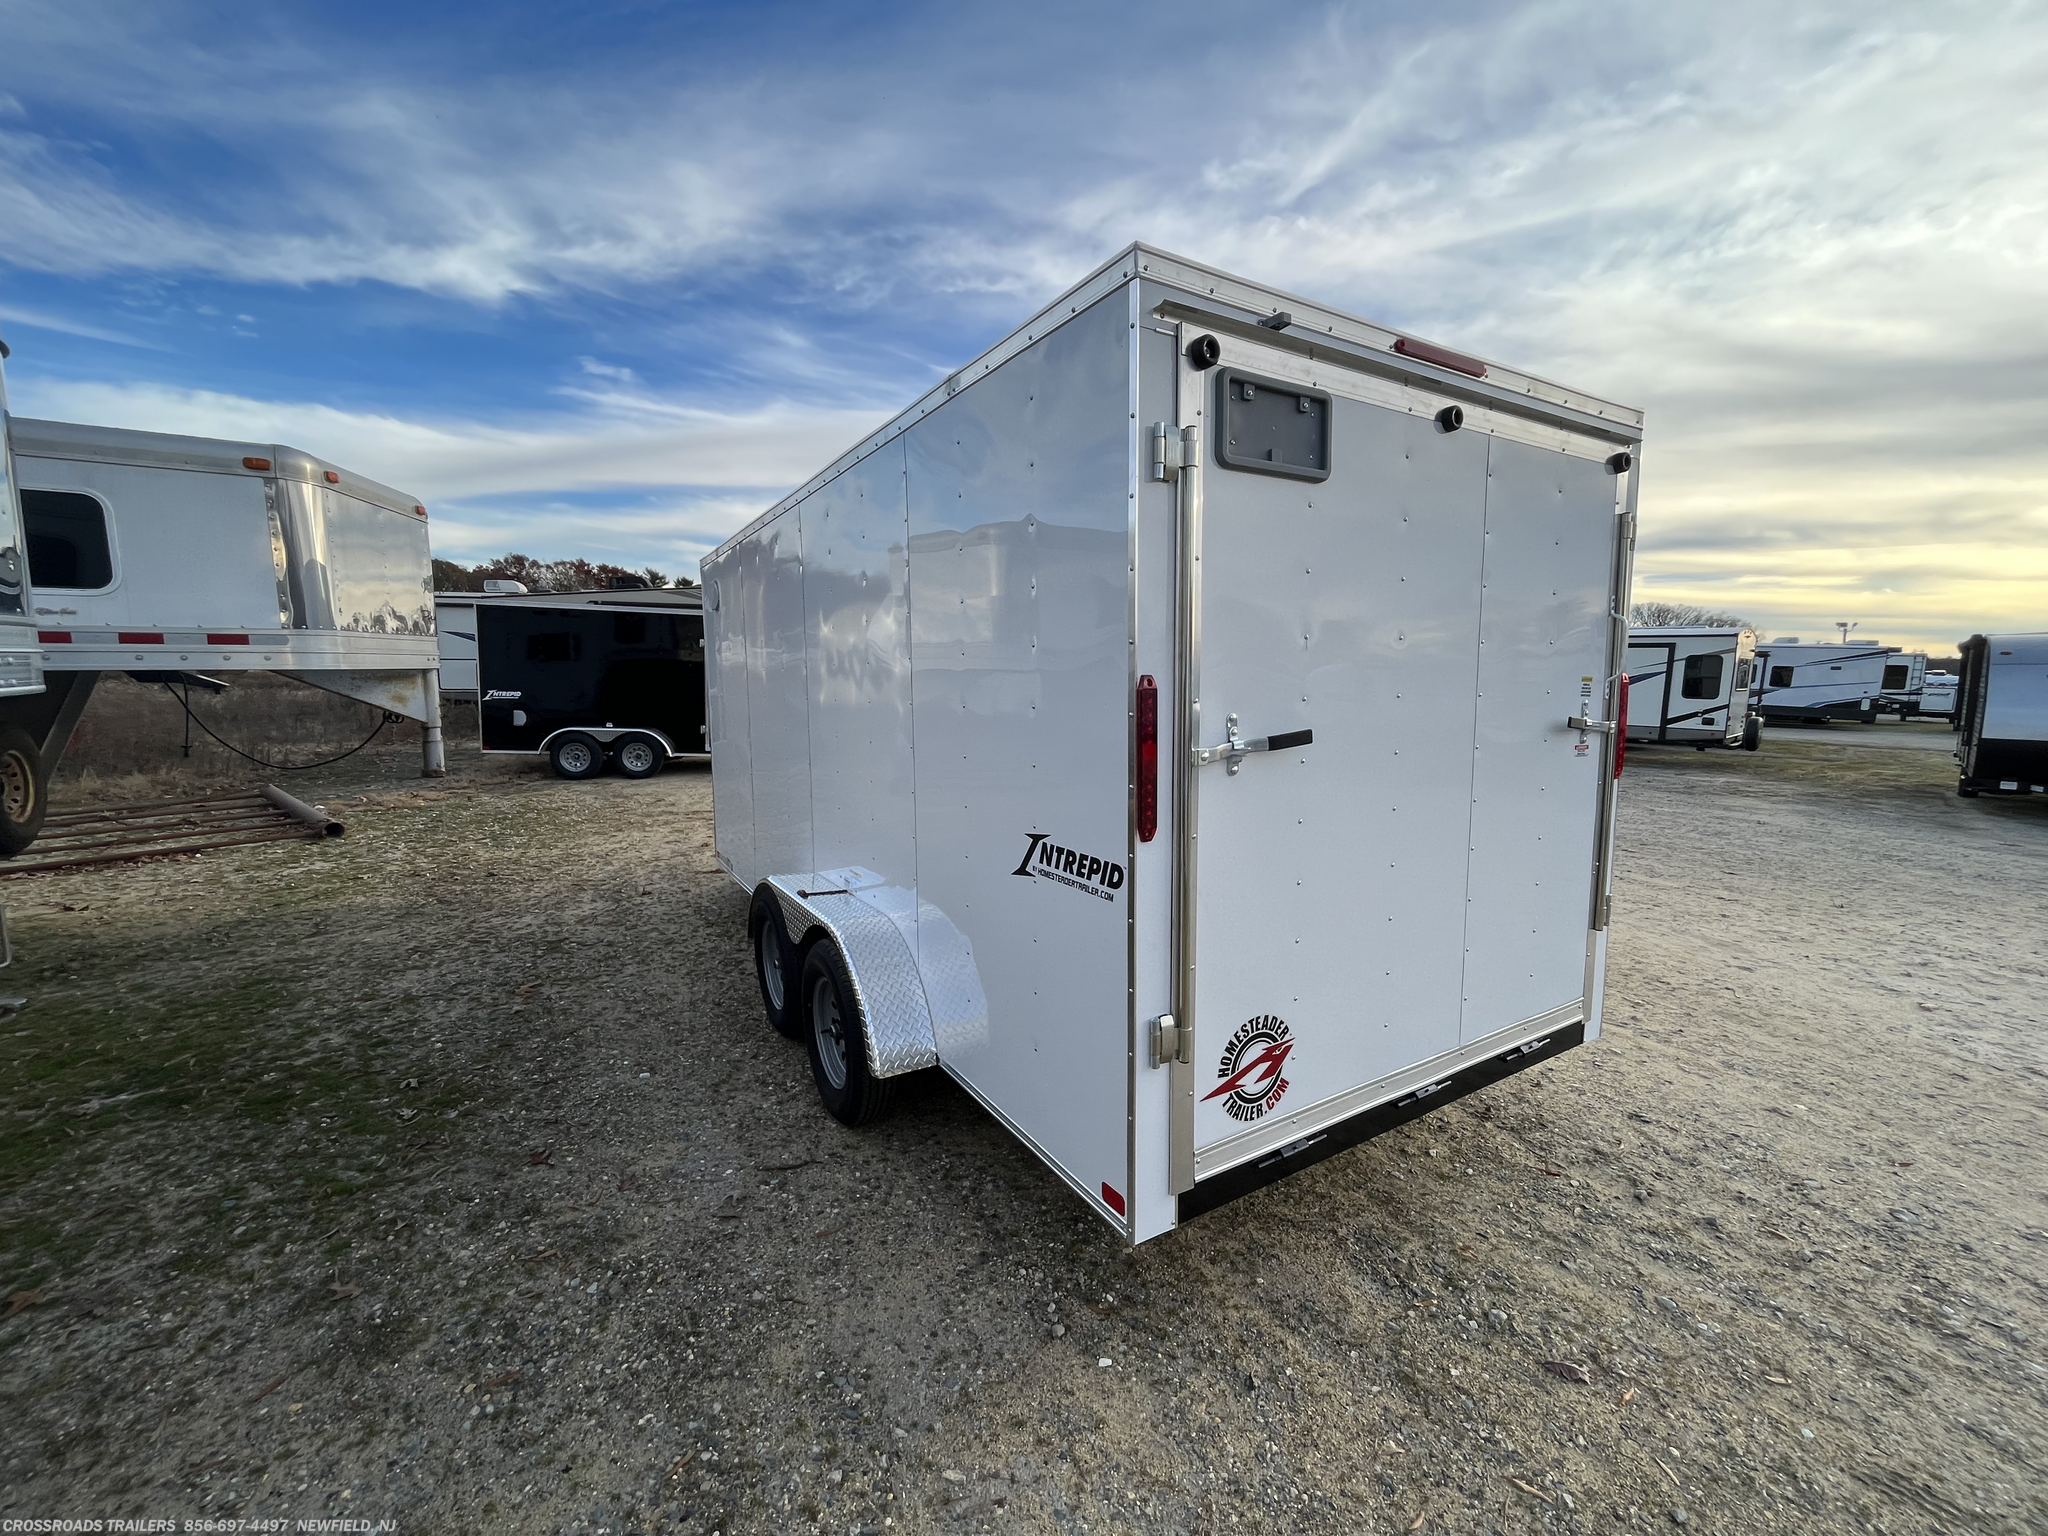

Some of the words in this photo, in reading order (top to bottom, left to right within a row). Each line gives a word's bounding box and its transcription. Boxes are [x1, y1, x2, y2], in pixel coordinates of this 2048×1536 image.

[482, 689, 522, 700] INTREPID
[1011, 833, 1125, 890] INTREPID
[1037, 868, 1114, 902] HOMESTEADERTRAILER.COM
[1217, 1014, 1290, 1079] HOMESTEADER
[1222, 1077, 1290, 1122] TRAILER.COM
